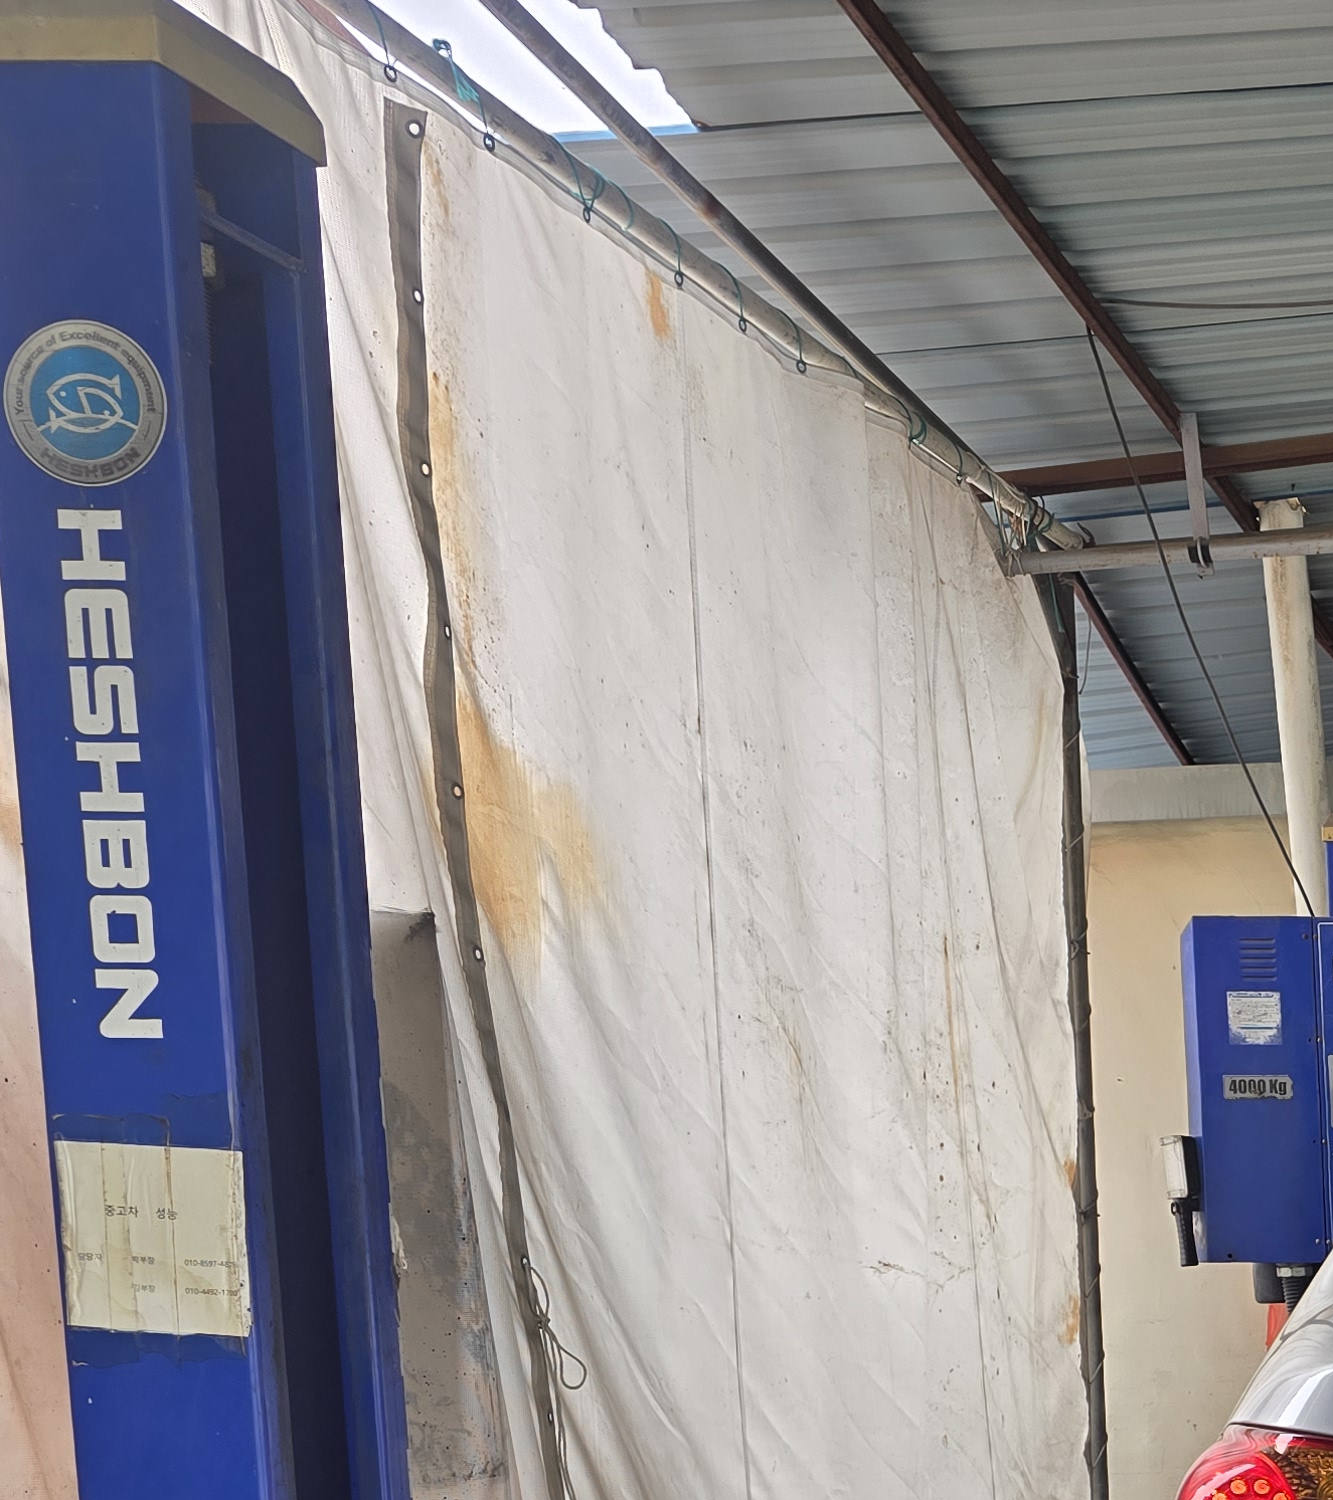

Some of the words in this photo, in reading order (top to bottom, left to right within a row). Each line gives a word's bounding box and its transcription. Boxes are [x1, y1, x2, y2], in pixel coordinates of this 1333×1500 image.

[56, 508, 163, 1040] HESHBON
[1228, 1079, 1266, 1096] 4000
[1269, 1079, 1287, 1096] Kg
[104, 1204, 139, 1218] 중고차
